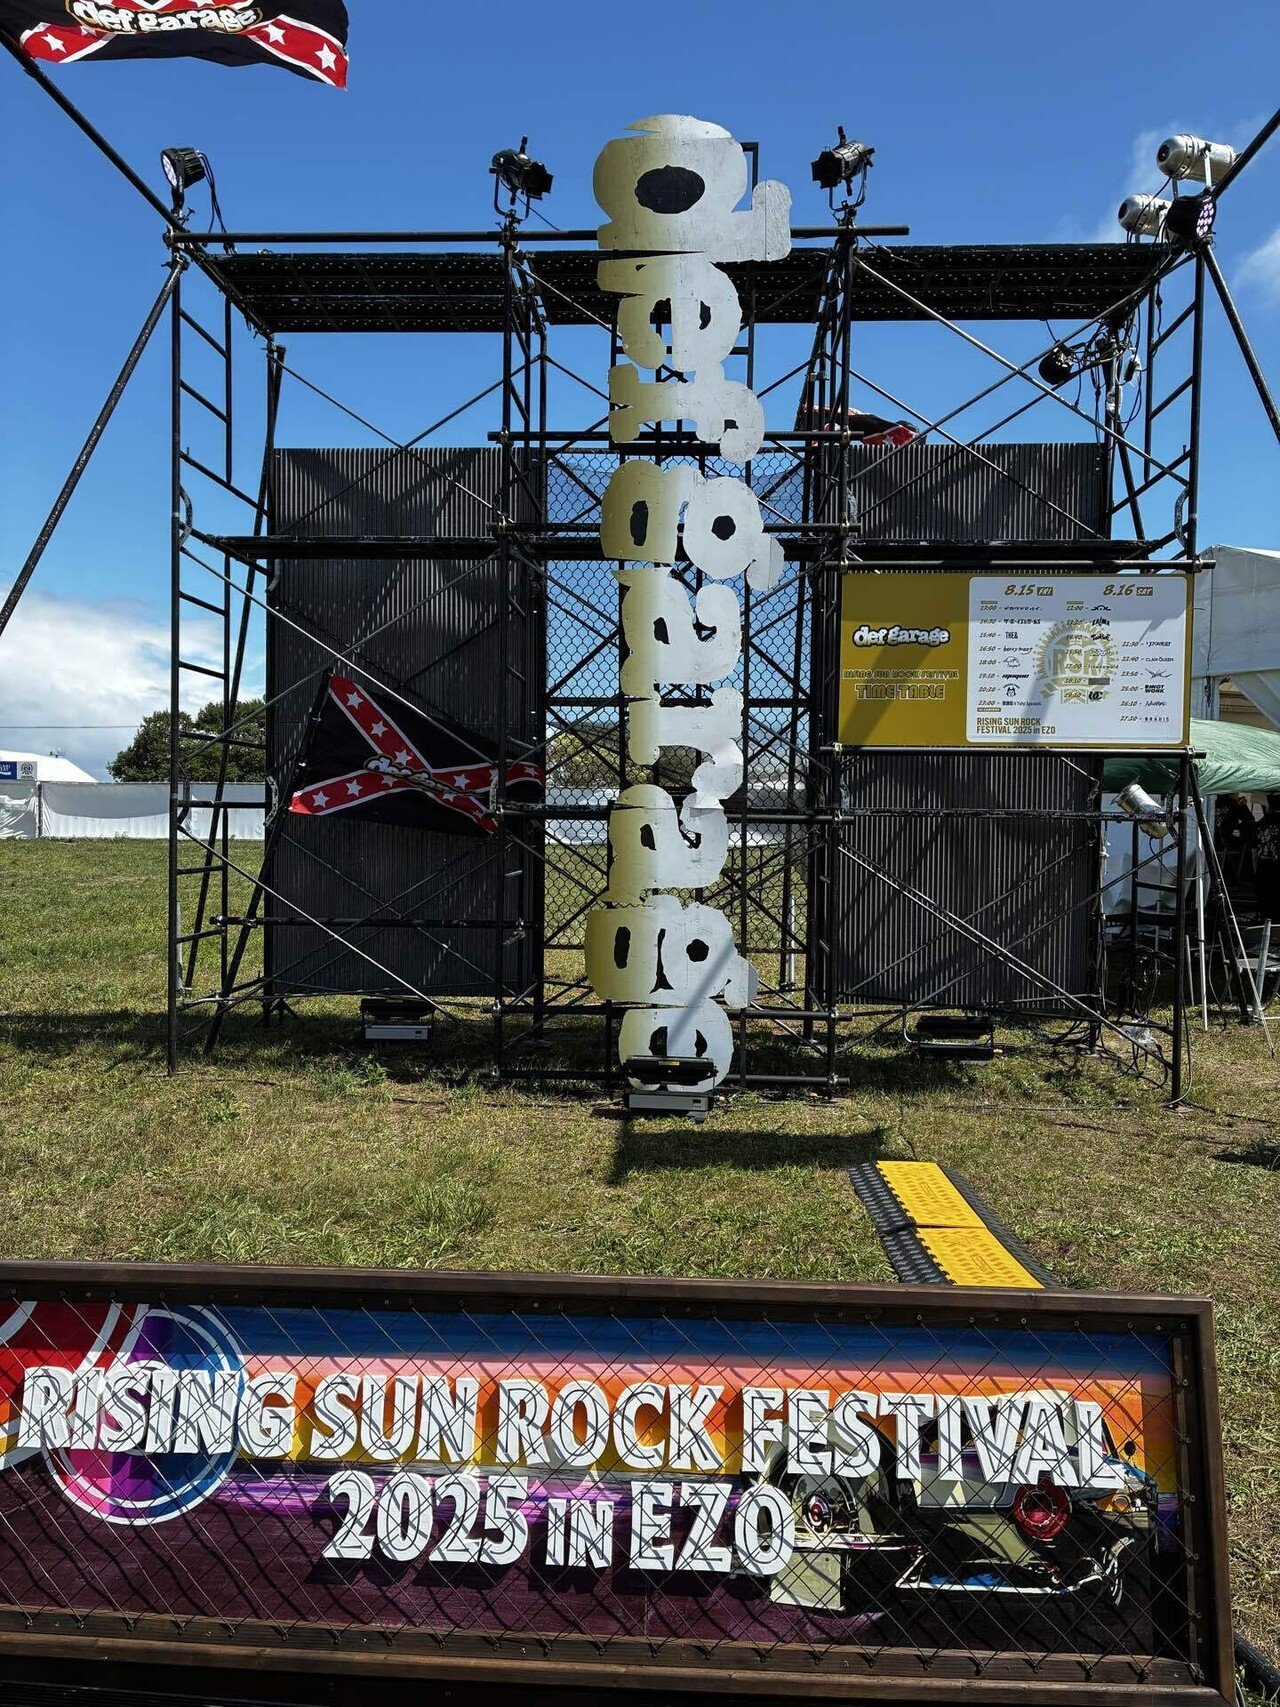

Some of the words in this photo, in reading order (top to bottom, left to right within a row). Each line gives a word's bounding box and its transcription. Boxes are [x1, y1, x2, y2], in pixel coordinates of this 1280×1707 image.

[72, 2, 134, 31] def
[136, 8, 259, 32] garage
[1004, 584, 1036, 596] 8.15
[1103, 584, 1135, 596] 8.16
[853, 625, 888, 646] def
[887, 625, 950, 647] garage
[896, 683, 946, 700] TABLE
[976, 717, 1003, 726] RISING
[1003, 717, 1019, 726] SUN
[1020, 717, 1041, 726] ROCK
[976, 725, 1012, 734] FESTIVAL
[1013, 725, 1032, 734] 2025
[1041, 726, 1056, 734] EZO
[17, 1365, 297, 1459] RISING
[309, 1372, 479, 1465] SUN
[497, 1378, 725, 1471] ROCK
[742, 1385, 1126, 1490] FESTIVAL
[322, 1470, 528, 1565] 2025
[545, 1498, 614, 1568] IN
[629, 1481, 795, 1576] EZO
